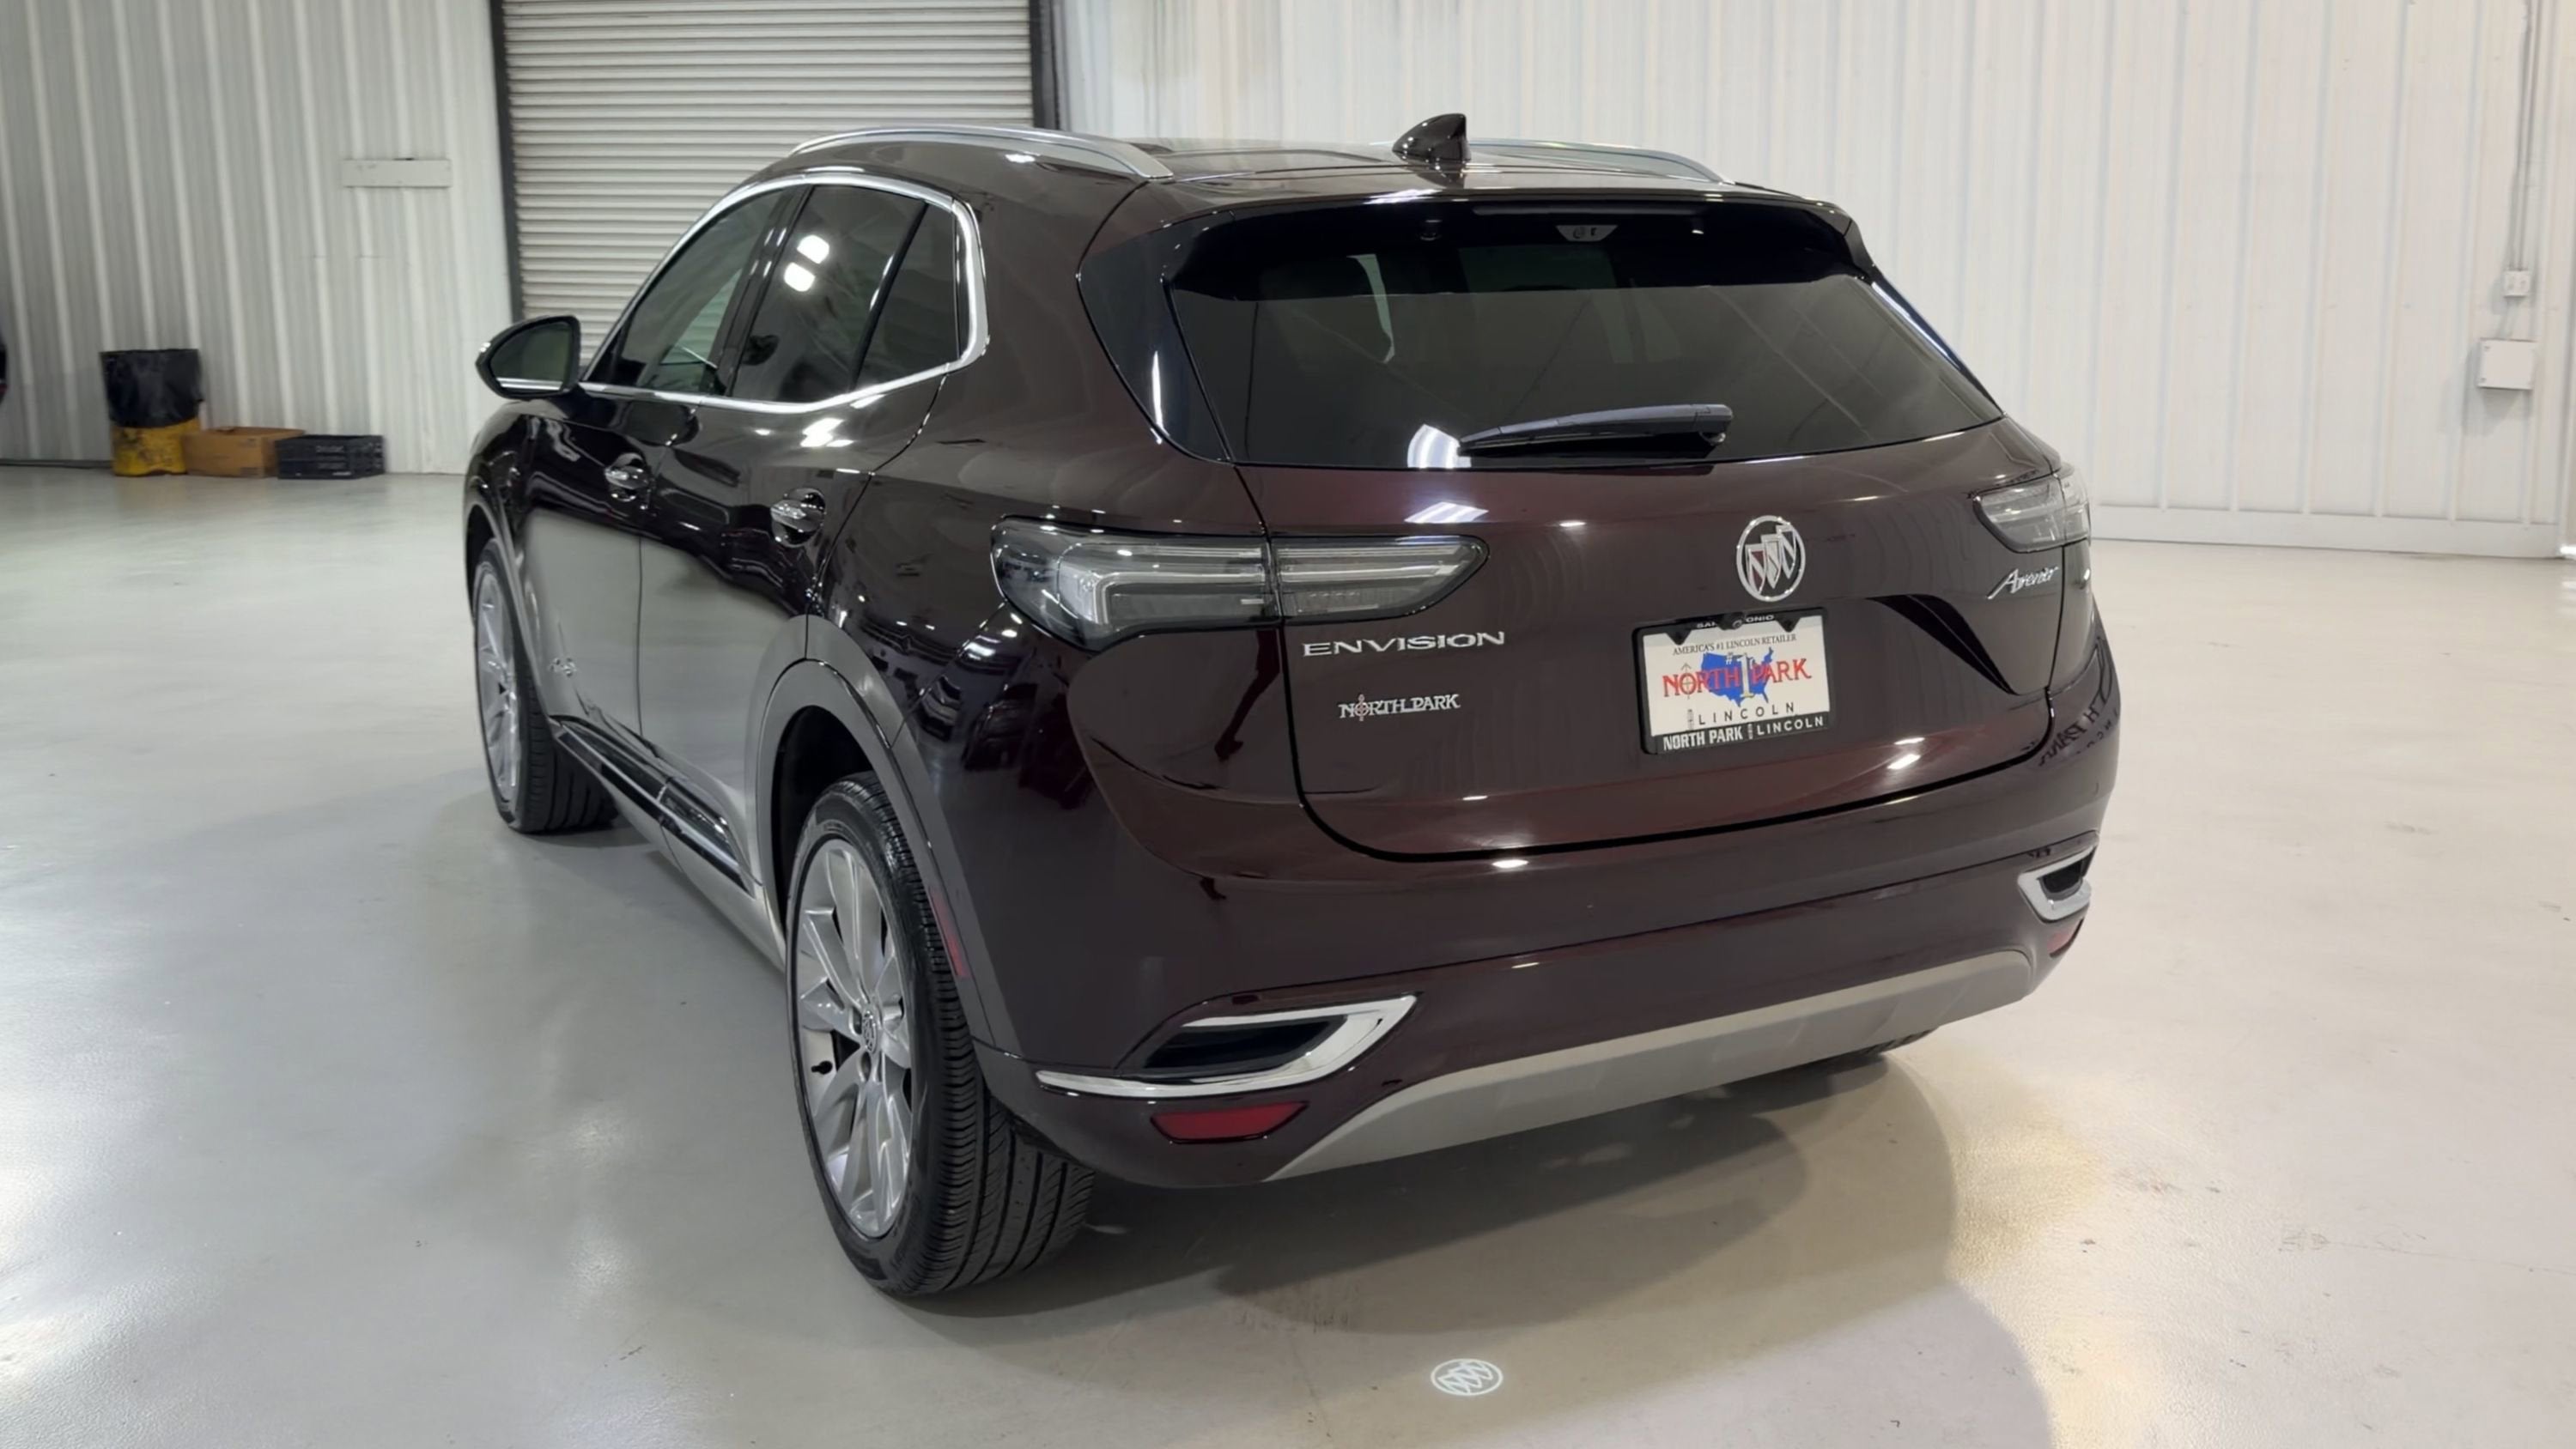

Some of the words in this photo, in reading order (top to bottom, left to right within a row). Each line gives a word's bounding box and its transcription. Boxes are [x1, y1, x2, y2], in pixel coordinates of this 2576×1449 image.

[1303, 631, 1504, 657] ENVISION
[1673, 642, 1716, 656] AMERICA'S
[1716, 642, 1725, 651] #1
[1725, 638, 1761, 650] LINCOLN
[1761, 634, 1797, 645] RETAILER
[1662, 665, 1741, 697] NORTH
[1751, 658, 1812, 685] PARK
[1338, 694, 1406, 720] NORTH
[1410, 694, 1461, 712] PARK
[1698, 702, 1795, 725] LINCOLN
[1662, 731, 1706, 752] NORTH
[1709, 725, 1743, 743] PARK
[1757, 716, 1824, 736] LINCOLN
